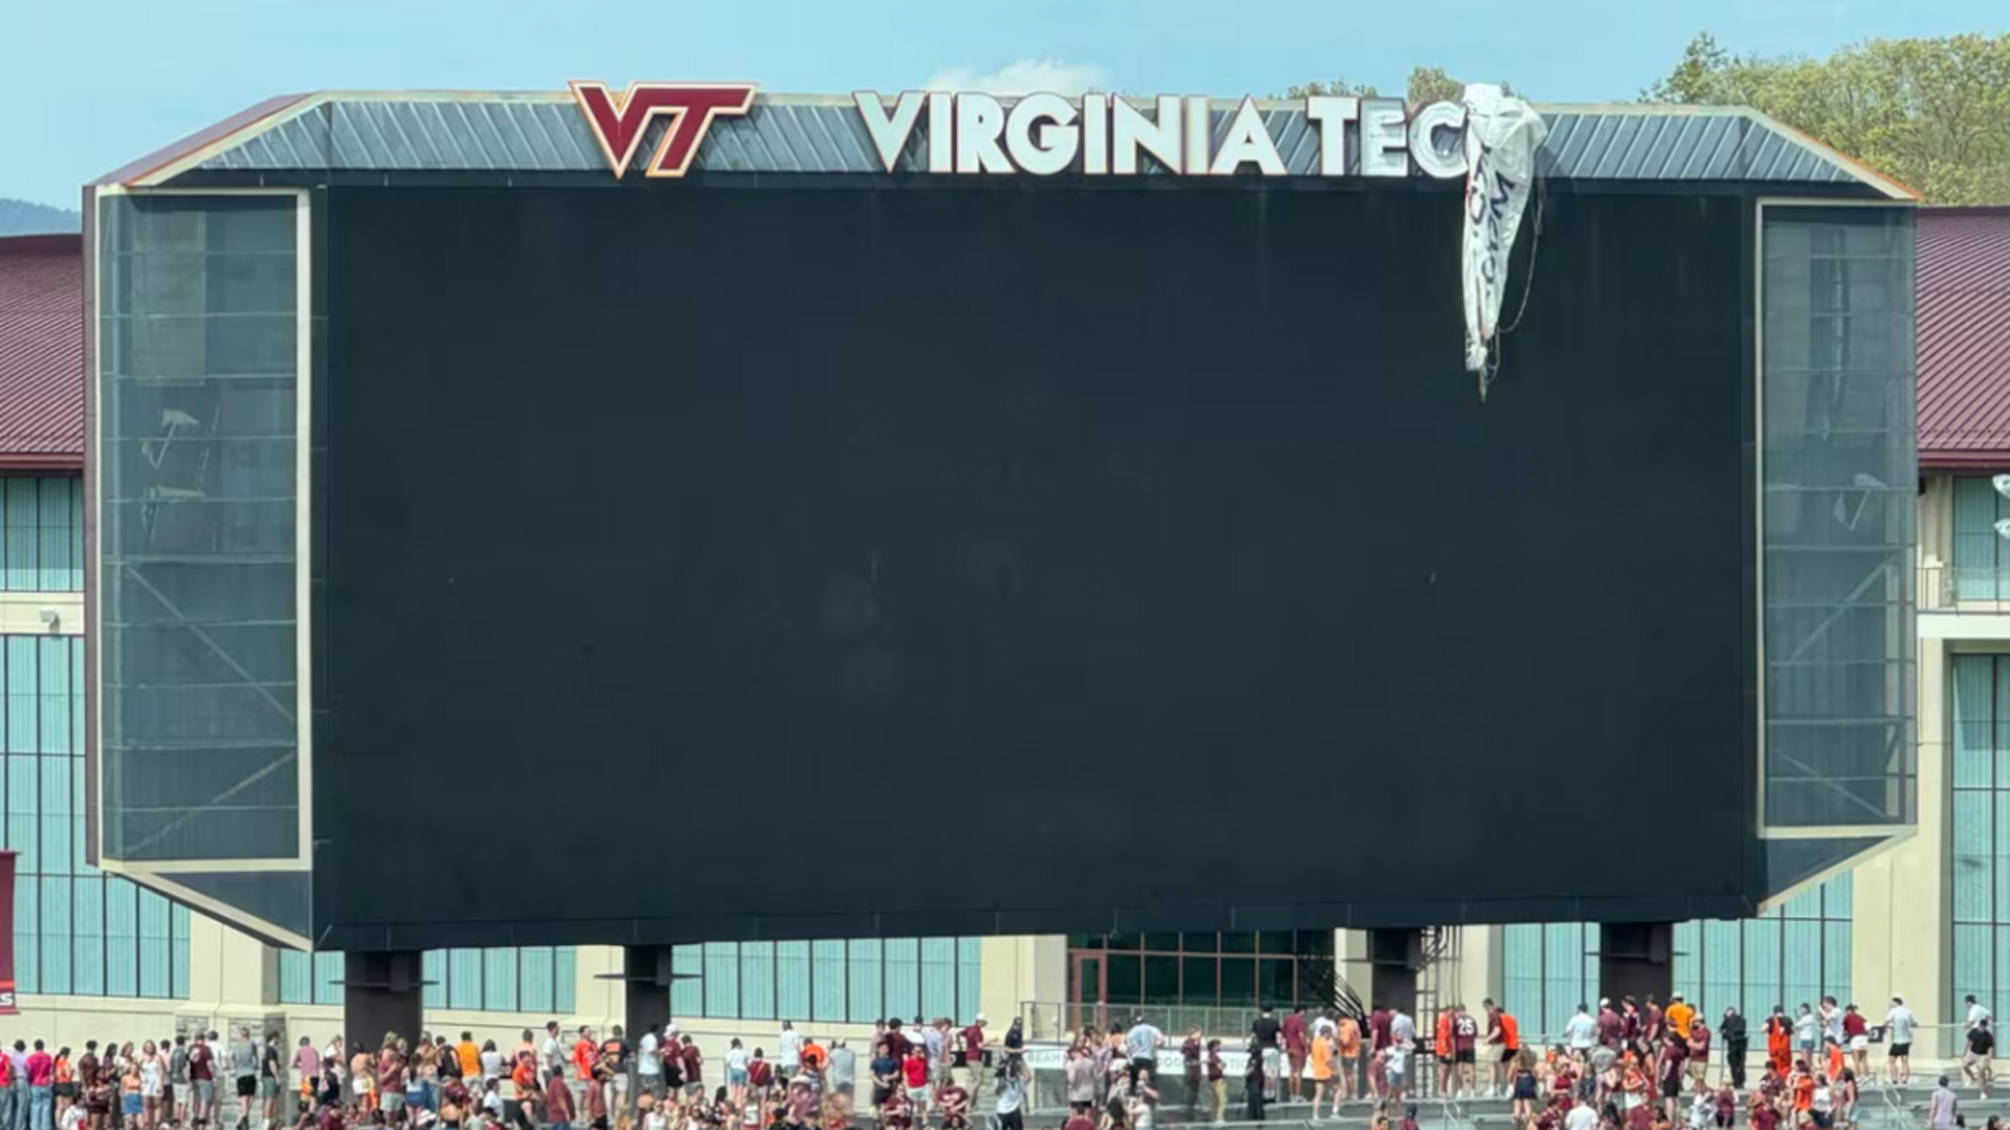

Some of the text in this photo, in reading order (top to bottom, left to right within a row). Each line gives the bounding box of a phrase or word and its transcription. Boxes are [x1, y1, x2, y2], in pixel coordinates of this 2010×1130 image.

[569, 81, 760, 178] VT
[852, 90, 1469, 178] VIRGINIA TEC
[1456, 1018, 1475, 1035] 25
